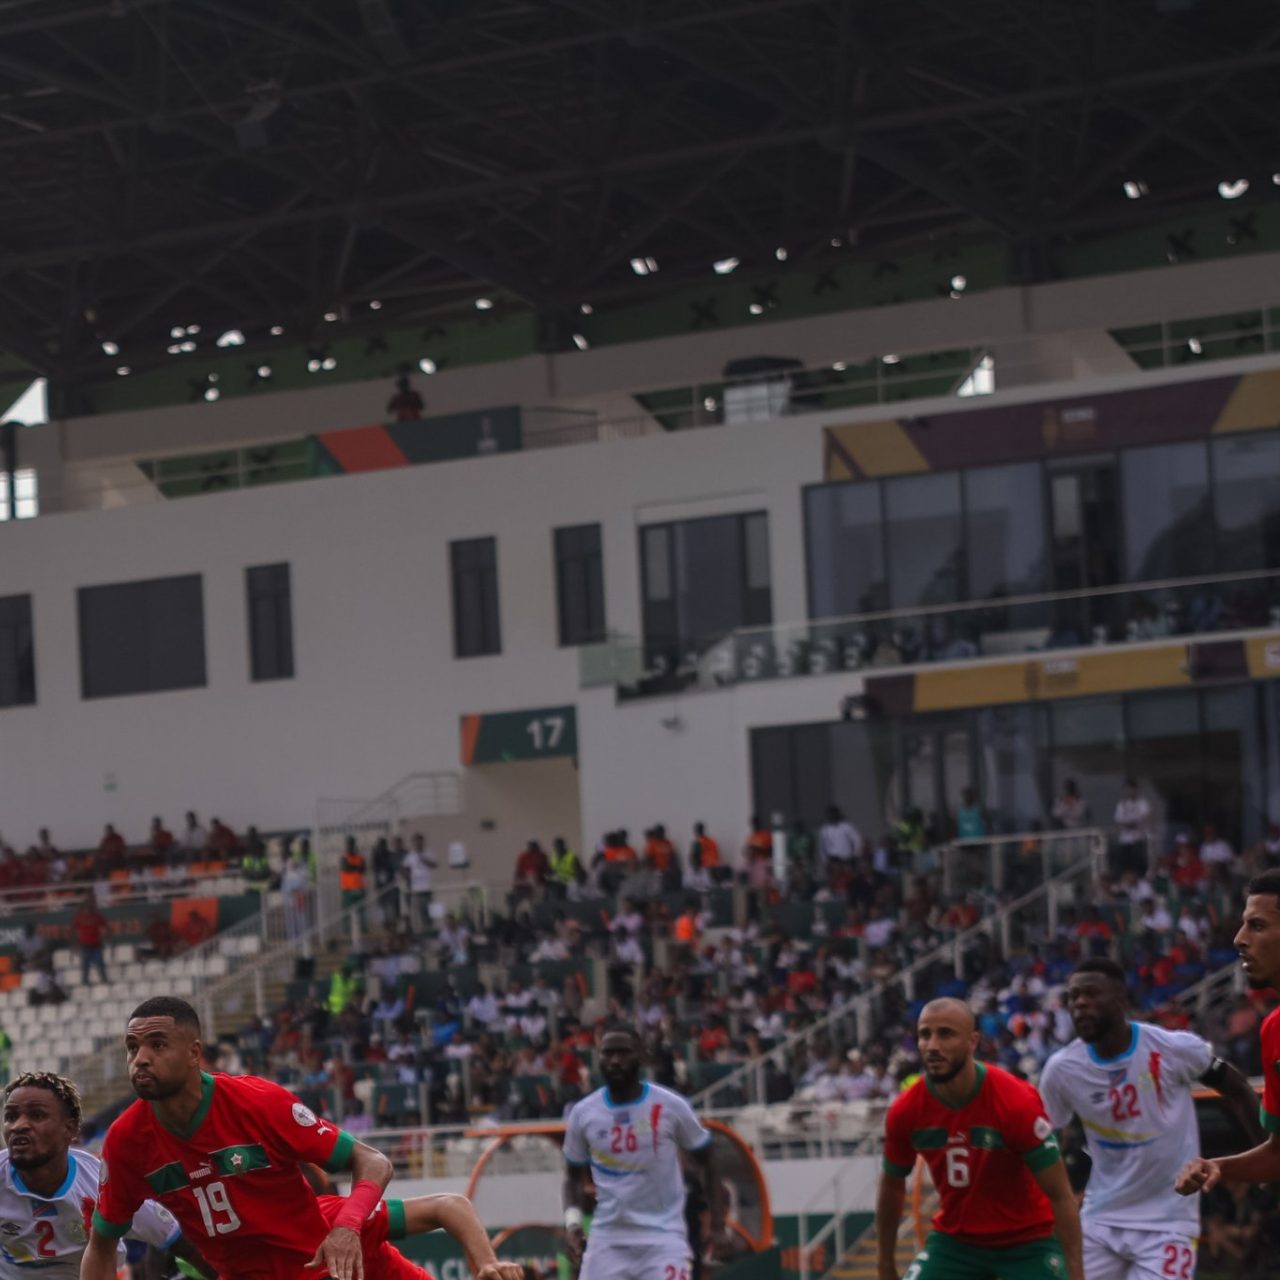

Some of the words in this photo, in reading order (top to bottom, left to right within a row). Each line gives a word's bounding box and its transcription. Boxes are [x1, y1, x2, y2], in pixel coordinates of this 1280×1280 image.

[526, 717, 563, 750] 17
[1109, 1083, 1141, 1122] 22
[611, 1125, 638, 1153] 26
[946, 1147, 970, 1187] 6
[192, 1181, 241, 1237] 19
[35, 1220, 57, 1257] 2
[1161, 1243, 1195, 1280] 22
